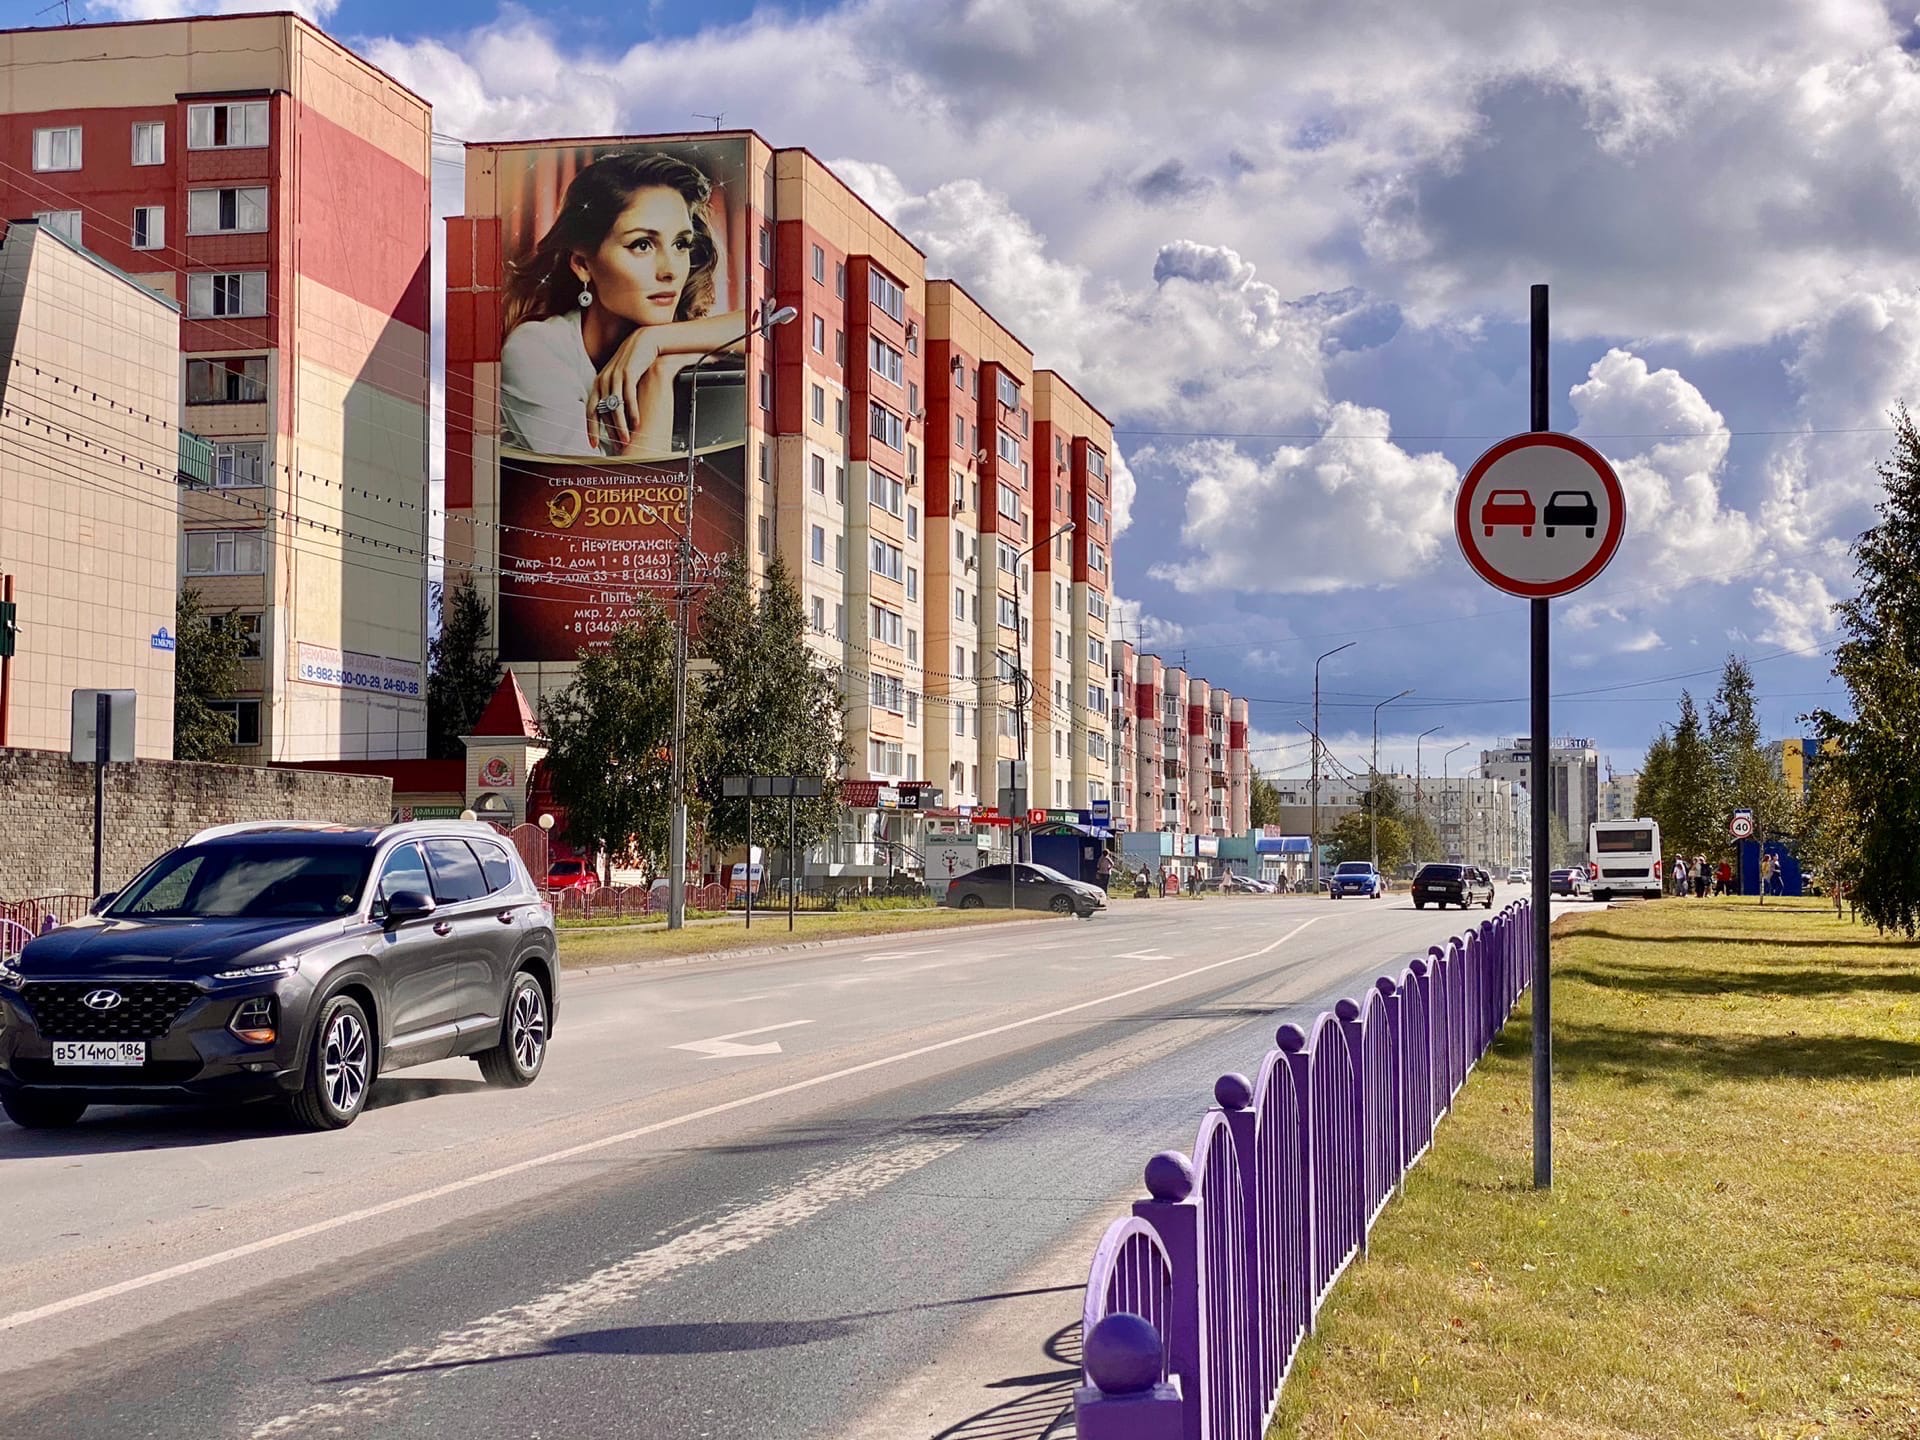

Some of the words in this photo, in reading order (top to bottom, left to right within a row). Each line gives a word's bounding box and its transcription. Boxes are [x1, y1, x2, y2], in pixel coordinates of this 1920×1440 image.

[549, 477, 574, 486] СЕТЬ
[576, 475, 642, 486] ЮВЕЛИРНЫХ
[644, 474, 690, 484] САЛОНО
[581, 539, 673, 552] НЕФТЕЮГАНСК
[515, 559, 544, 570] мкр.
[549, 557, 565, 568] 12,
[569, 559, 597, 569] дом
[601, 556, 606, 566] 1
[622, 555, 629, 566] 8
[633, 553, 671, 568] (3463)
[593, 570, 608, 581] 33
[622, 570, 629, 580] 8
[633, 568, 672, 583] (3463)
[574, 609, 602, 619] мкр.
[574, 622, 582, 632] 8
[383, 678, 419, 694] 24-60-86
[1735, 823, 1748, 831] 40
[57, 1043, 117, 1060] В514МО
[119, 1043, 141, 1056] 186
